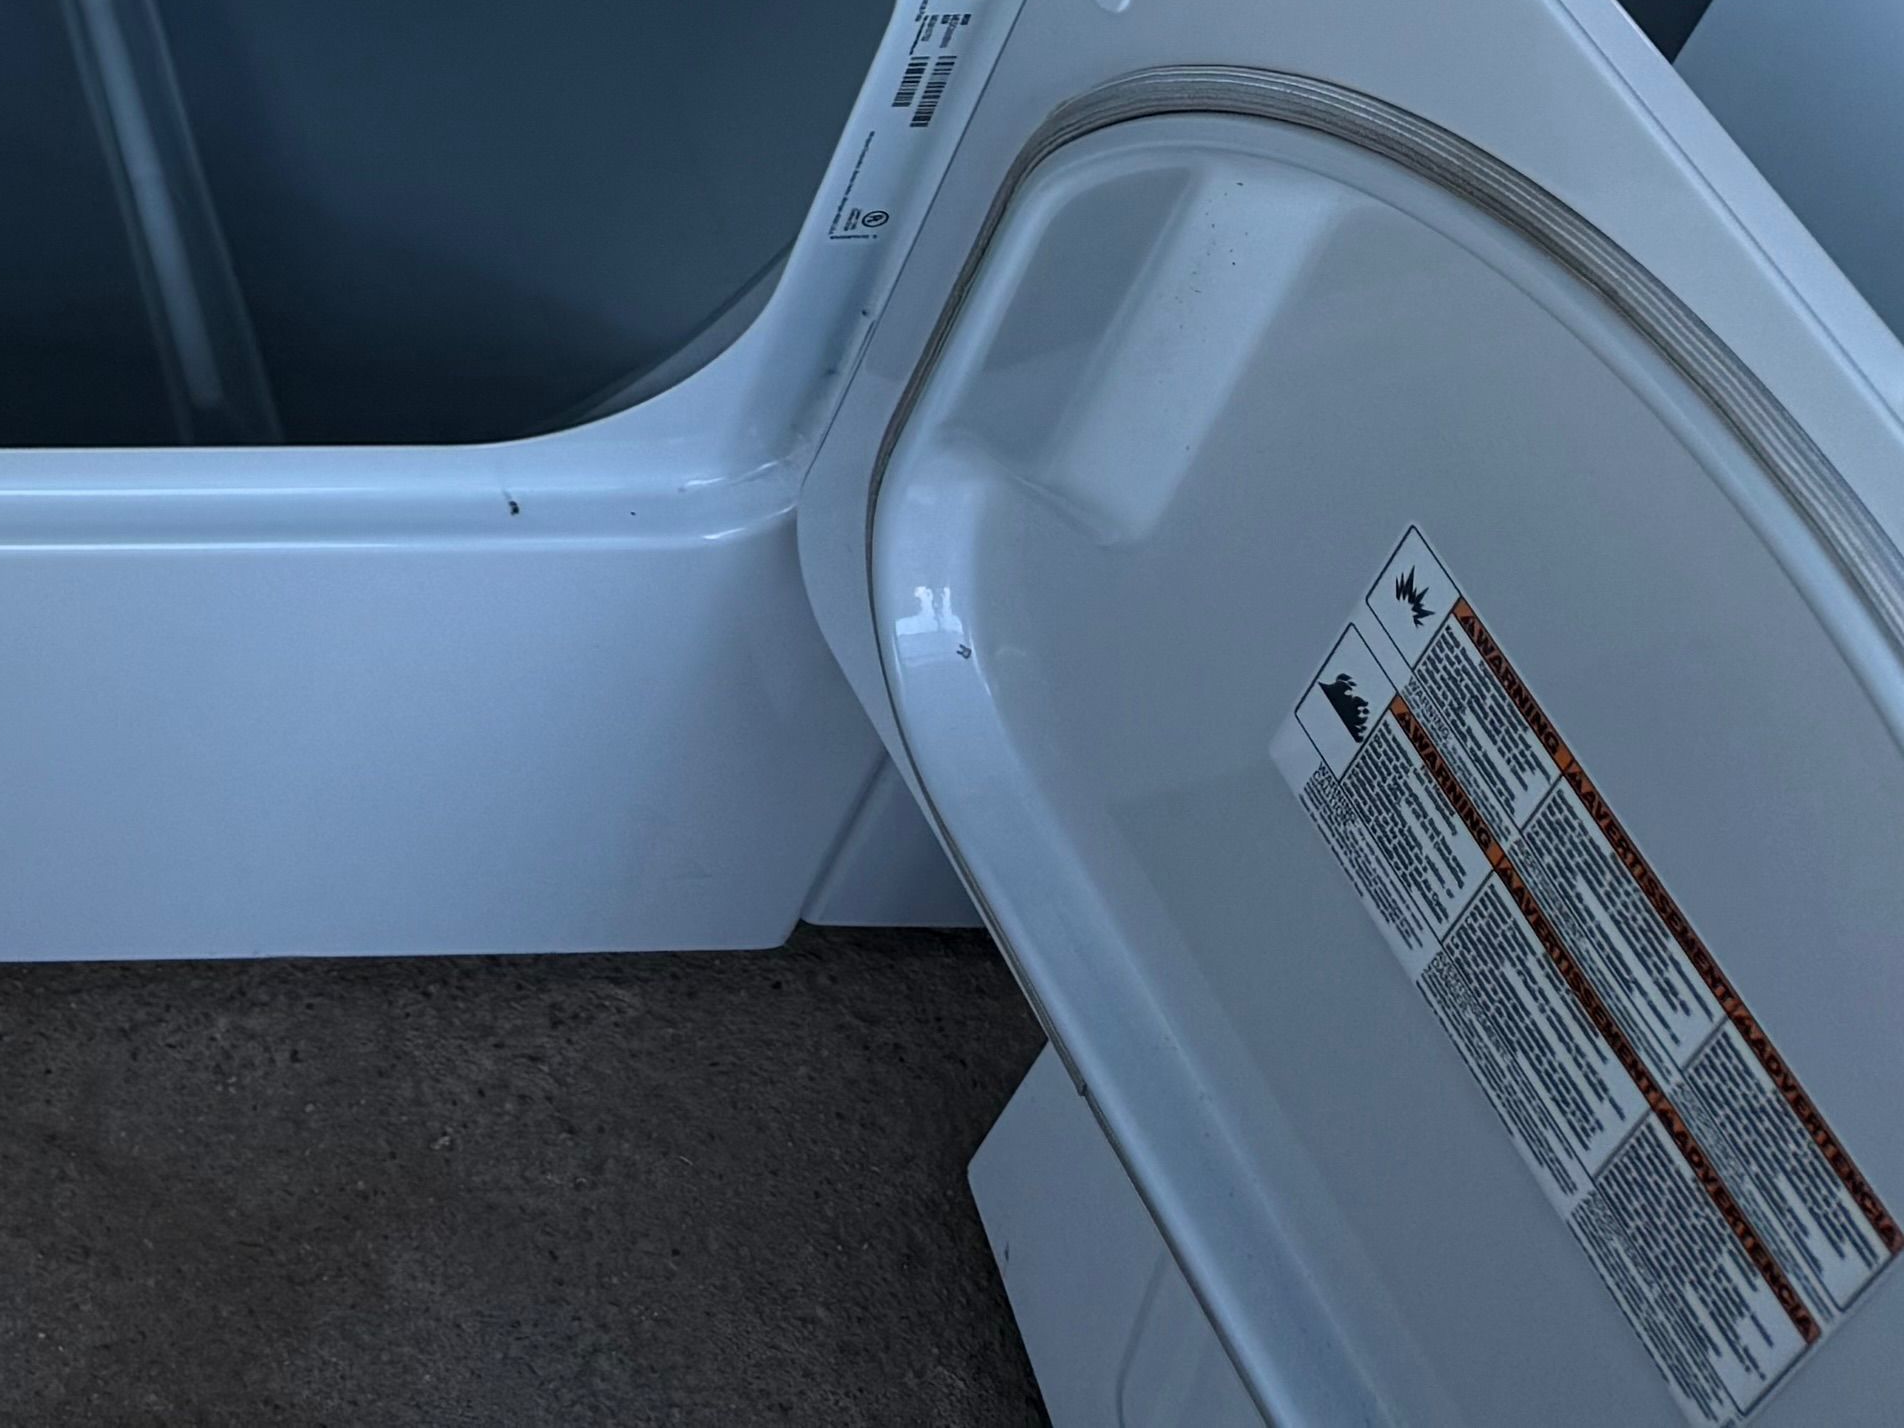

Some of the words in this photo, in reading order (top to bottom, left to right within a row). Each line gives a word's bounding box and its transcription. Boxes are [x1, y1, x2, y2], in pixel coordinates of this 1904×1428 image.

[1407, 724, 1494, 850] WARNING
[1470, 628, 1563, 755] WARNING
[1508, 880, 1659, 1097] AVERTISSEMENT
[1579, 787, 1735, 1005] AVERTISSEMENT
[1668, 1122, 1816, 1338] ADVERTENCIA
[1749, 1033, 1901, 1249] ADVERTENCIA
